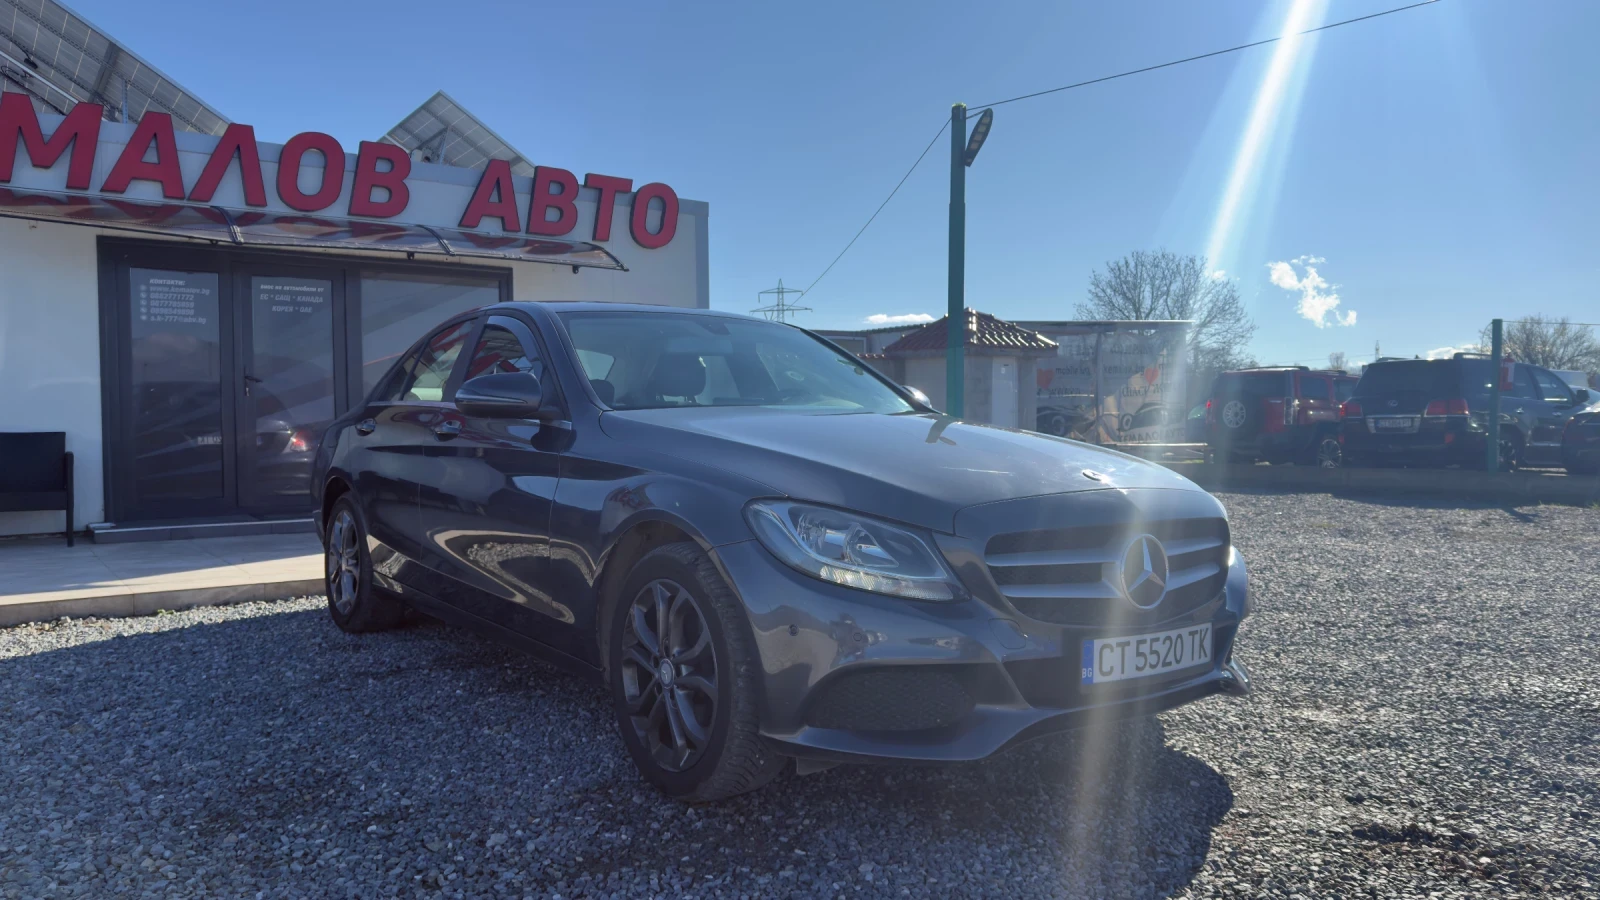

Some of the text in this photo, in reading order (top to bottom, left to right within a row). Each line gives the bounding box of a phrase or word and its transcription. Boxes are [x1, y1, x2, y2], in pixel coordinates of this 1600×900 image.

[458, 158, 680, 250] АВТО
[297, 295, 323, 303] КАНАДА
[272, 305, 294, 313] КОРЕЯ
[1135, 633, 1185, 672] 5520
[1081, 667, 1093, 679] BG
